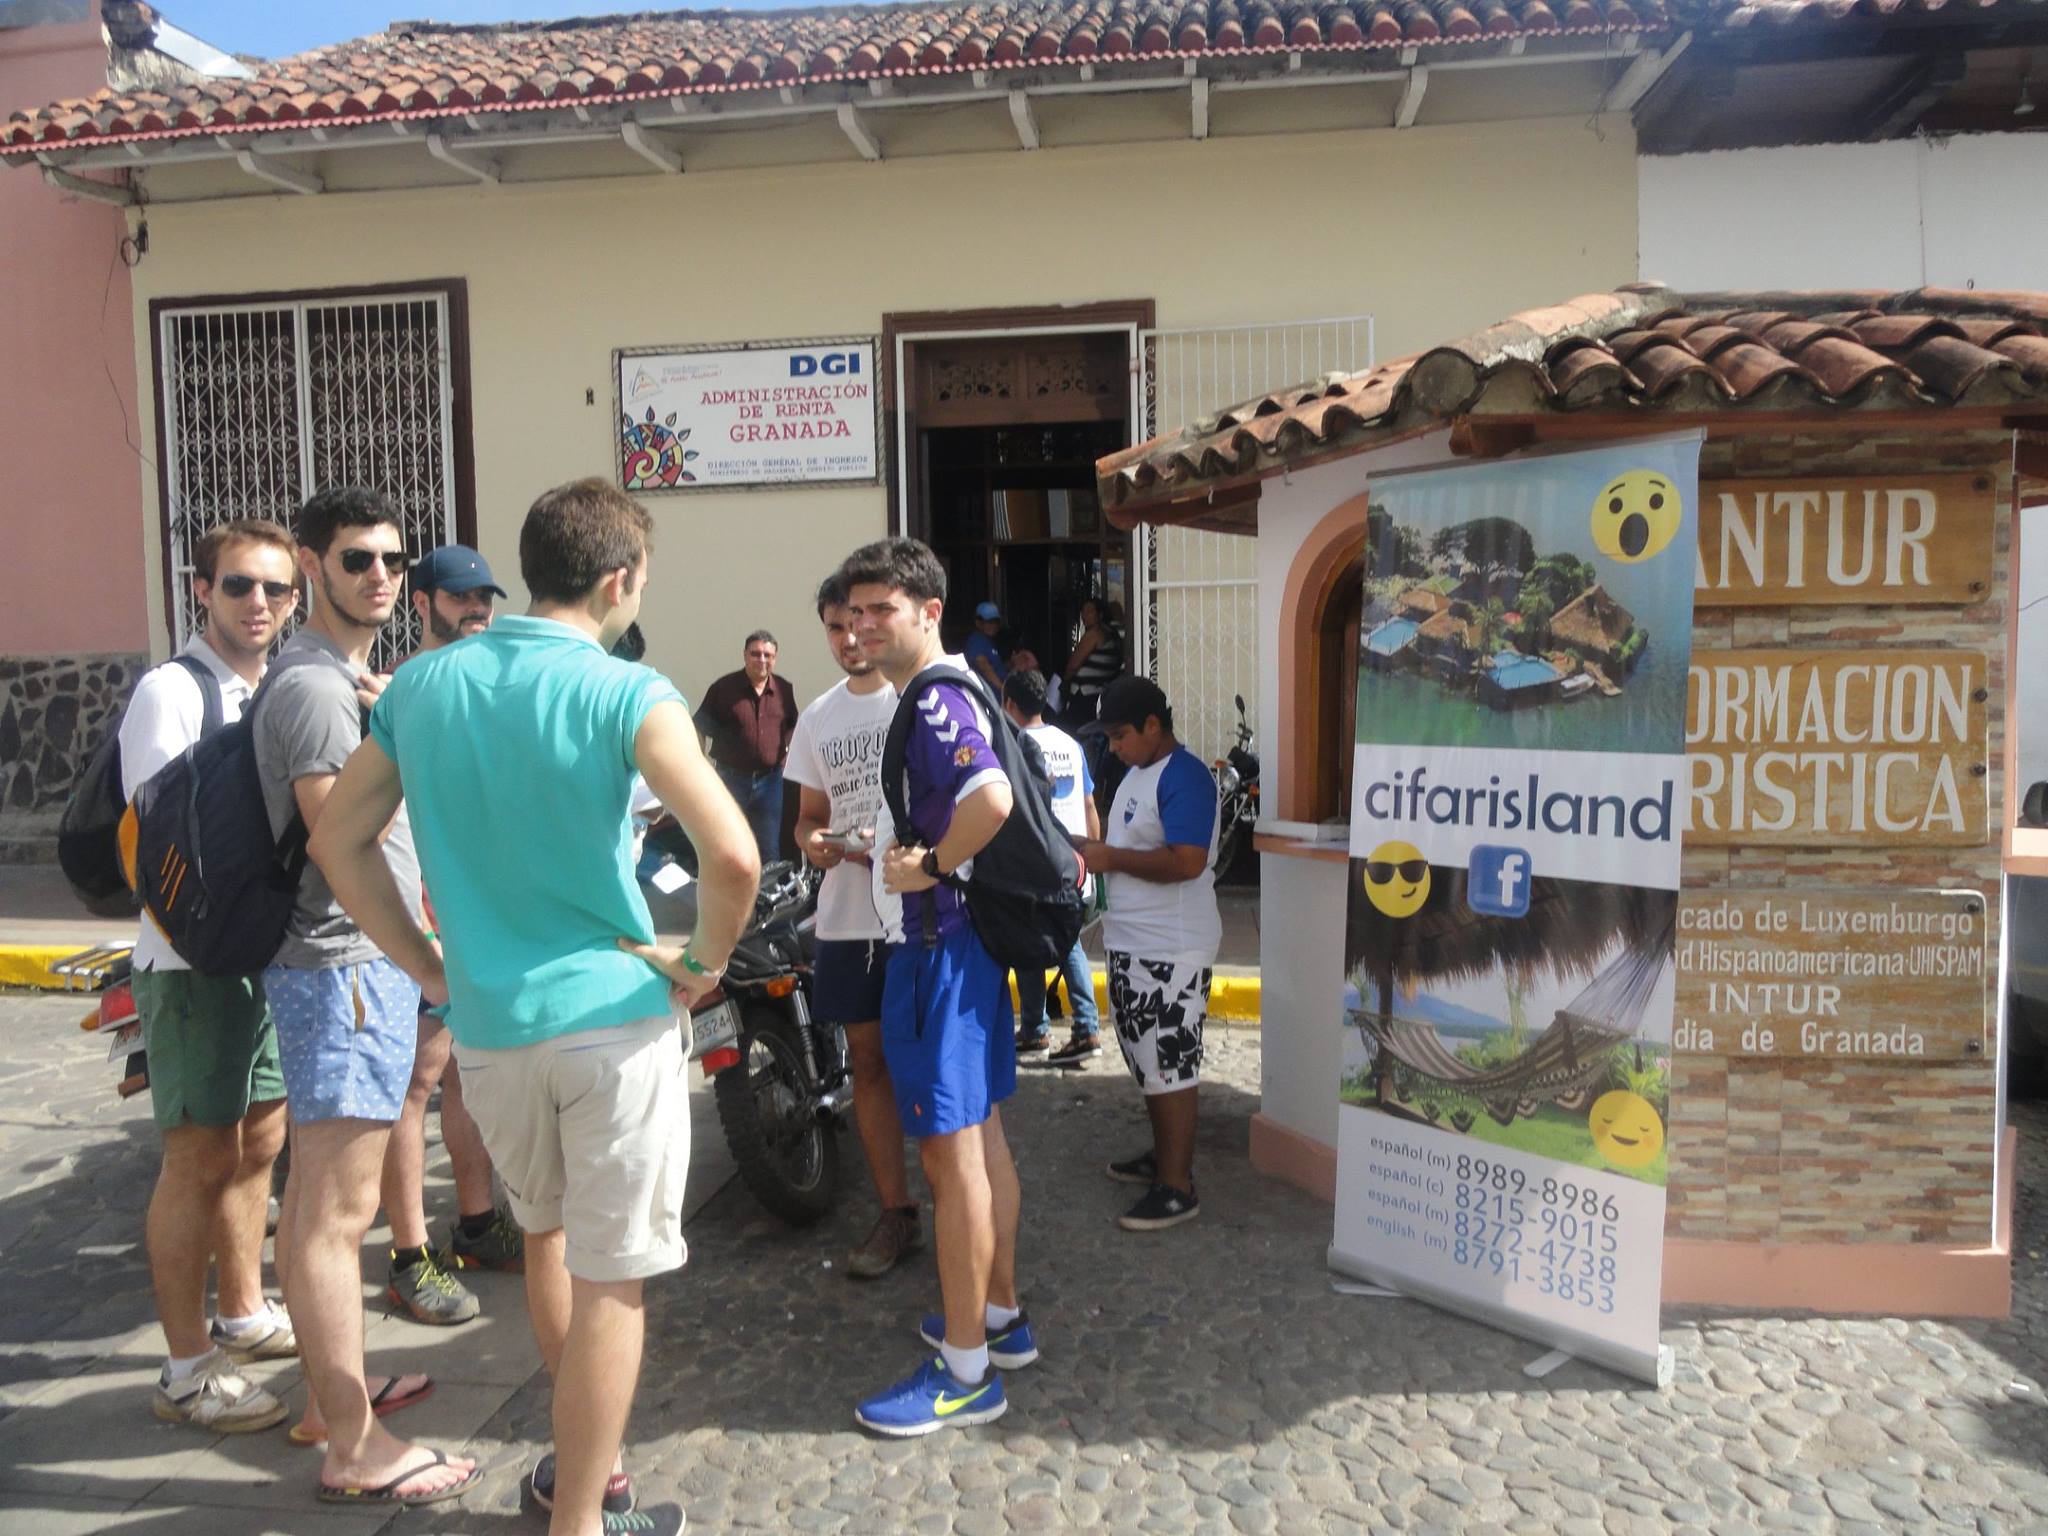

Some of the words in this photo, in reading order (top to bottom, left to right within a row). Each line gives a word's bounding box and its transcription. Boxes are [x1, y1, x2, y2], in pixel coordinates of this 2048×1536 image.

[790, 353, 860, 377] DGI
[701, 380, 868, 405] ADMINISTRACIÓN
[739, 405, 763, 419] DE
[776, 401, 836, 418] RENTA
[729, 420, 851, 443] GRANADA
[1695, 489, 1937, 589] NTUR
[1365, 766, 1674, 841] cifarisland
[1755, 901, 1788, 933] de
[1801, 901, 1973, 939] Luxemburgo
[1708, 982, 1841, 1016] INTUR
[1741, 1022, 1775, 1053] de
[1801, 1022, 1924, 1055] Granada
[1370, 1136, 1423, 1161] español
[1427, 1149, 1451, 1173] (m)
[1456, 1154, 1620, 1223] 8989-8986
[1369, 1161, 1422, 1188] español
[1426, 1175, 1445, 1197] (c)
[1456, 1183, 1618, 1254] 8215-9015
[1367, 1188, 1421, 1215] español
[1425, 1201, 1449, 1225] (m)
[1455, 1211, 1617, 1284] 8272-4738
[1366, 1213, 1416, 1241] english
[1424, 1227, 1448, 1251] (m)
[1454, 1240, 1615, 1314] 8791-3853
